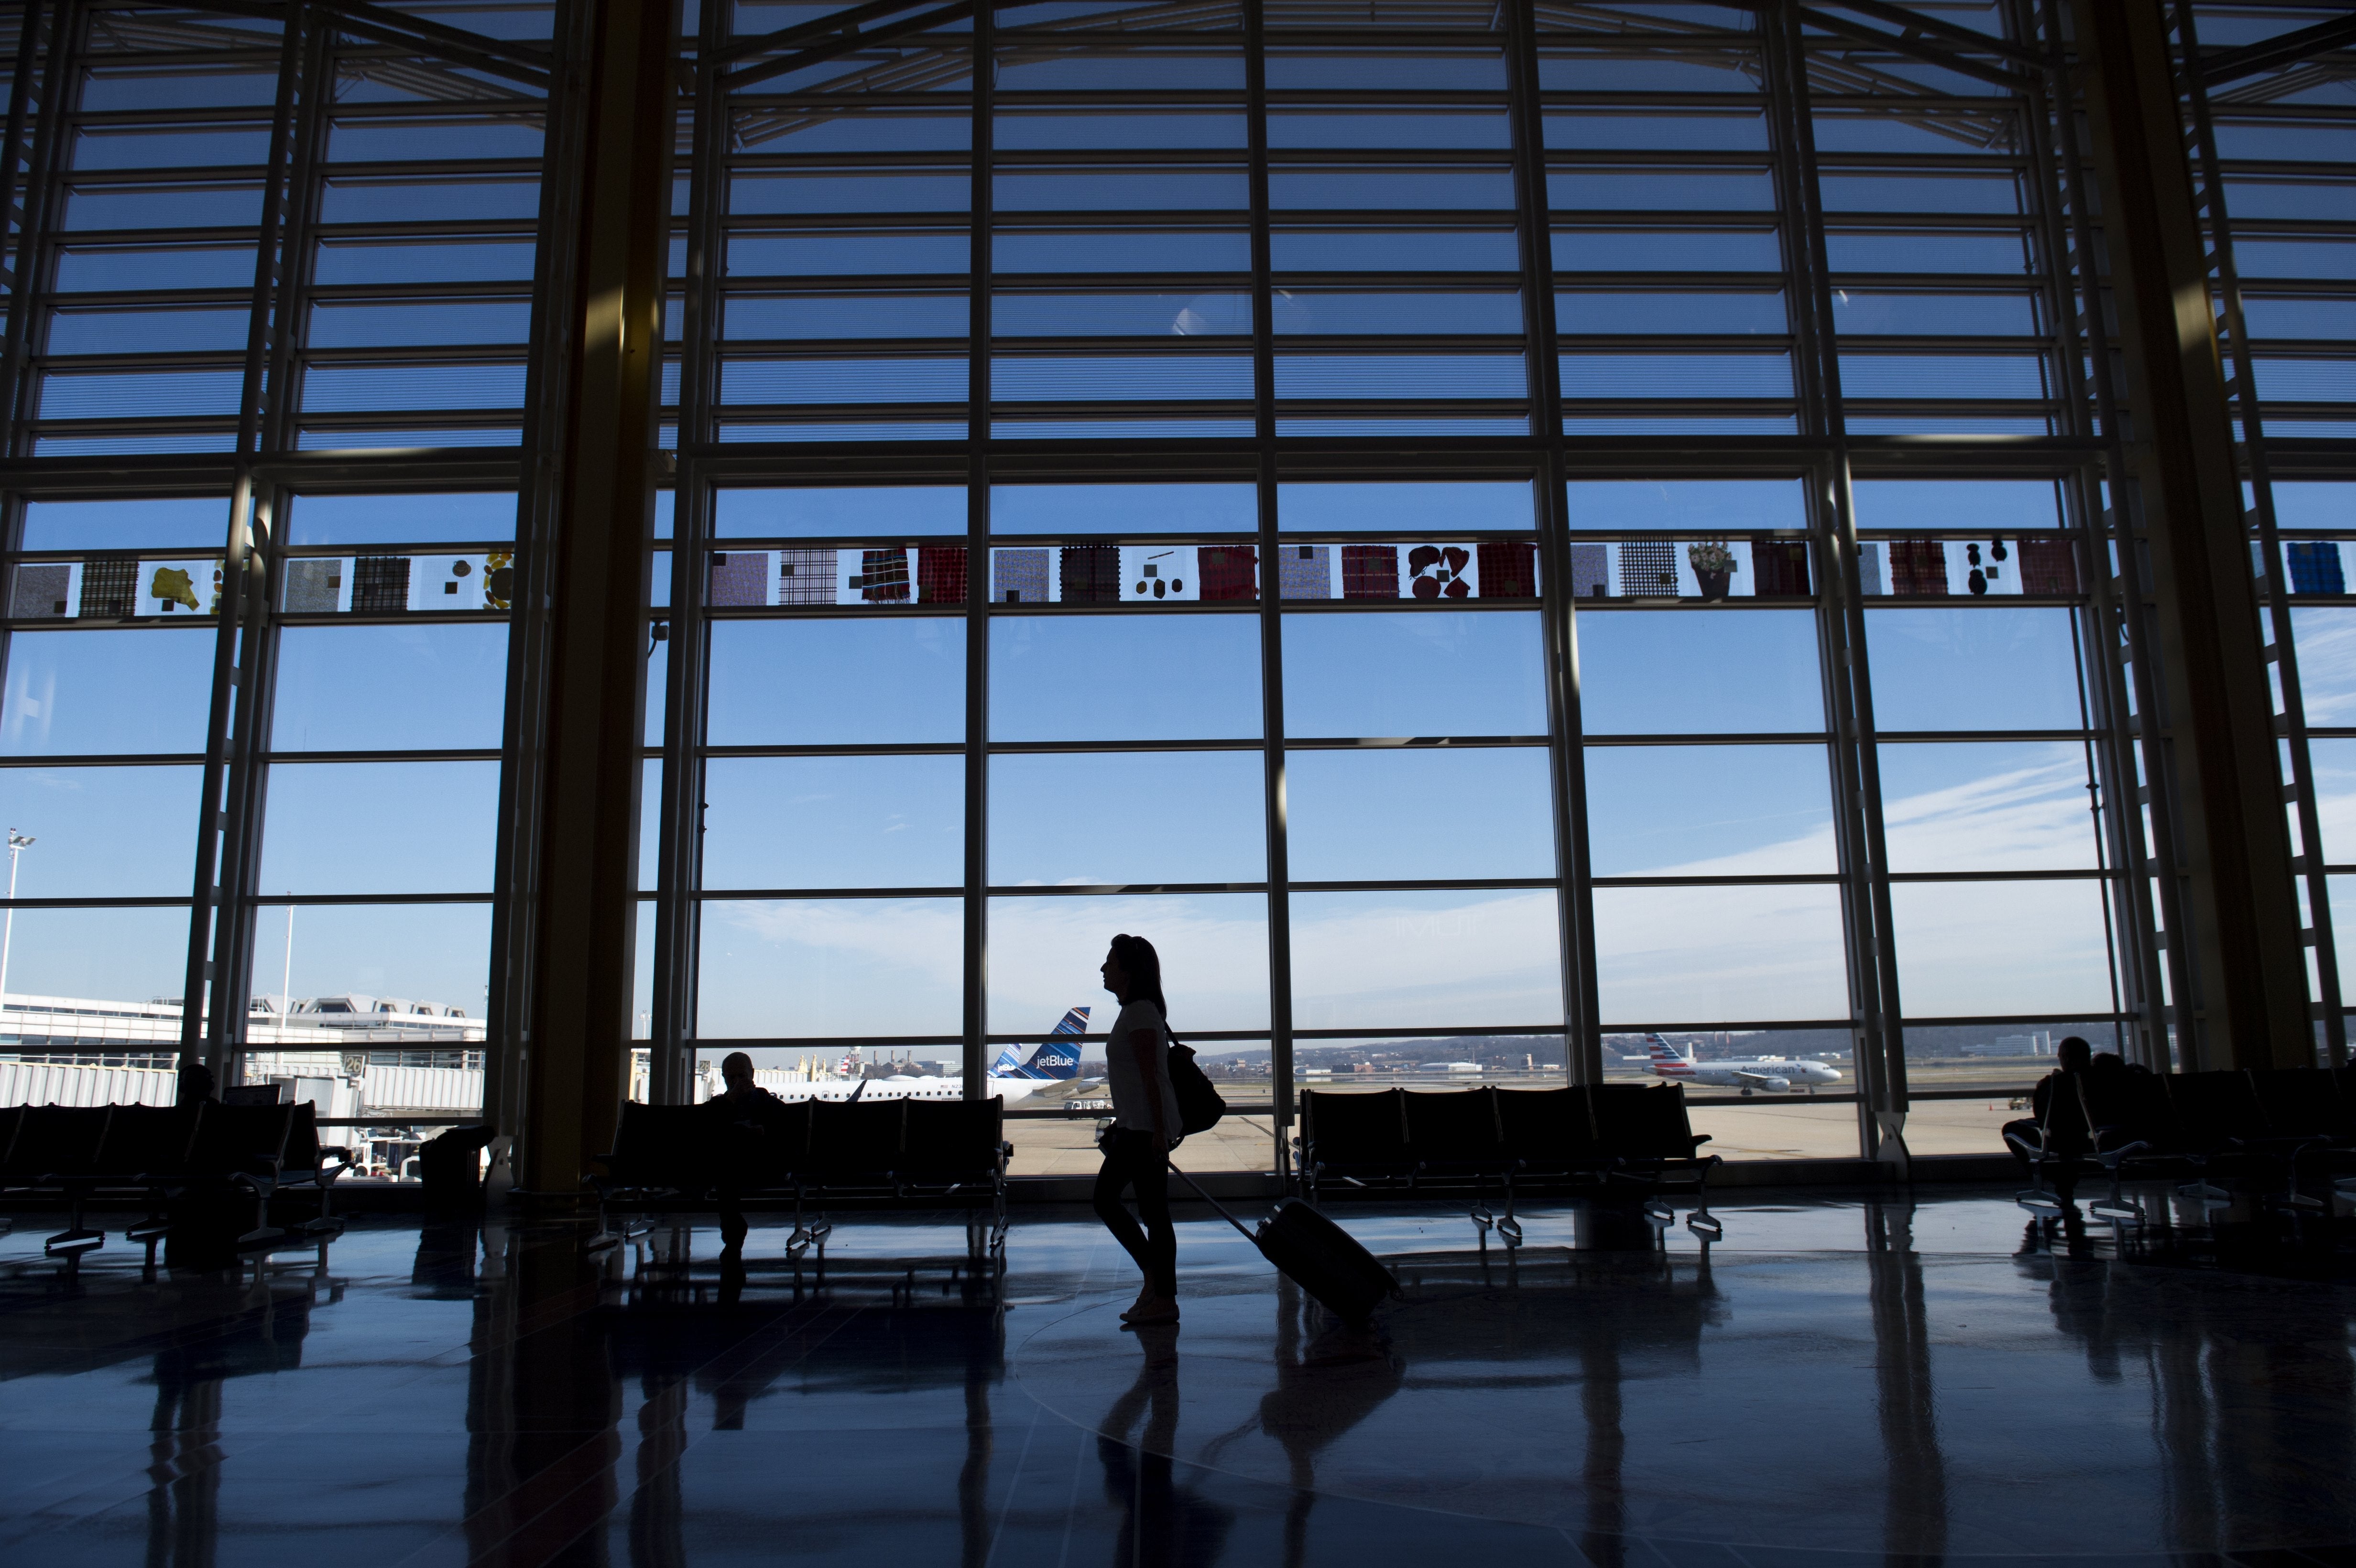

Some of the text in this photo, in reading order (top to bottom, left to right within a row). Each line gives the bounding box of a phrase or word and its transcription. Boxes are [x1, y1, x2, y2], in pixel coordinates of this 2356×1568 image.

[345, 1056, 361, 1072] 26
[699, 1061, 709, 1071] 28
[1036, 1055, 1073, 1069] jetBlue
[1740, 1065, 1795, 1074] American
